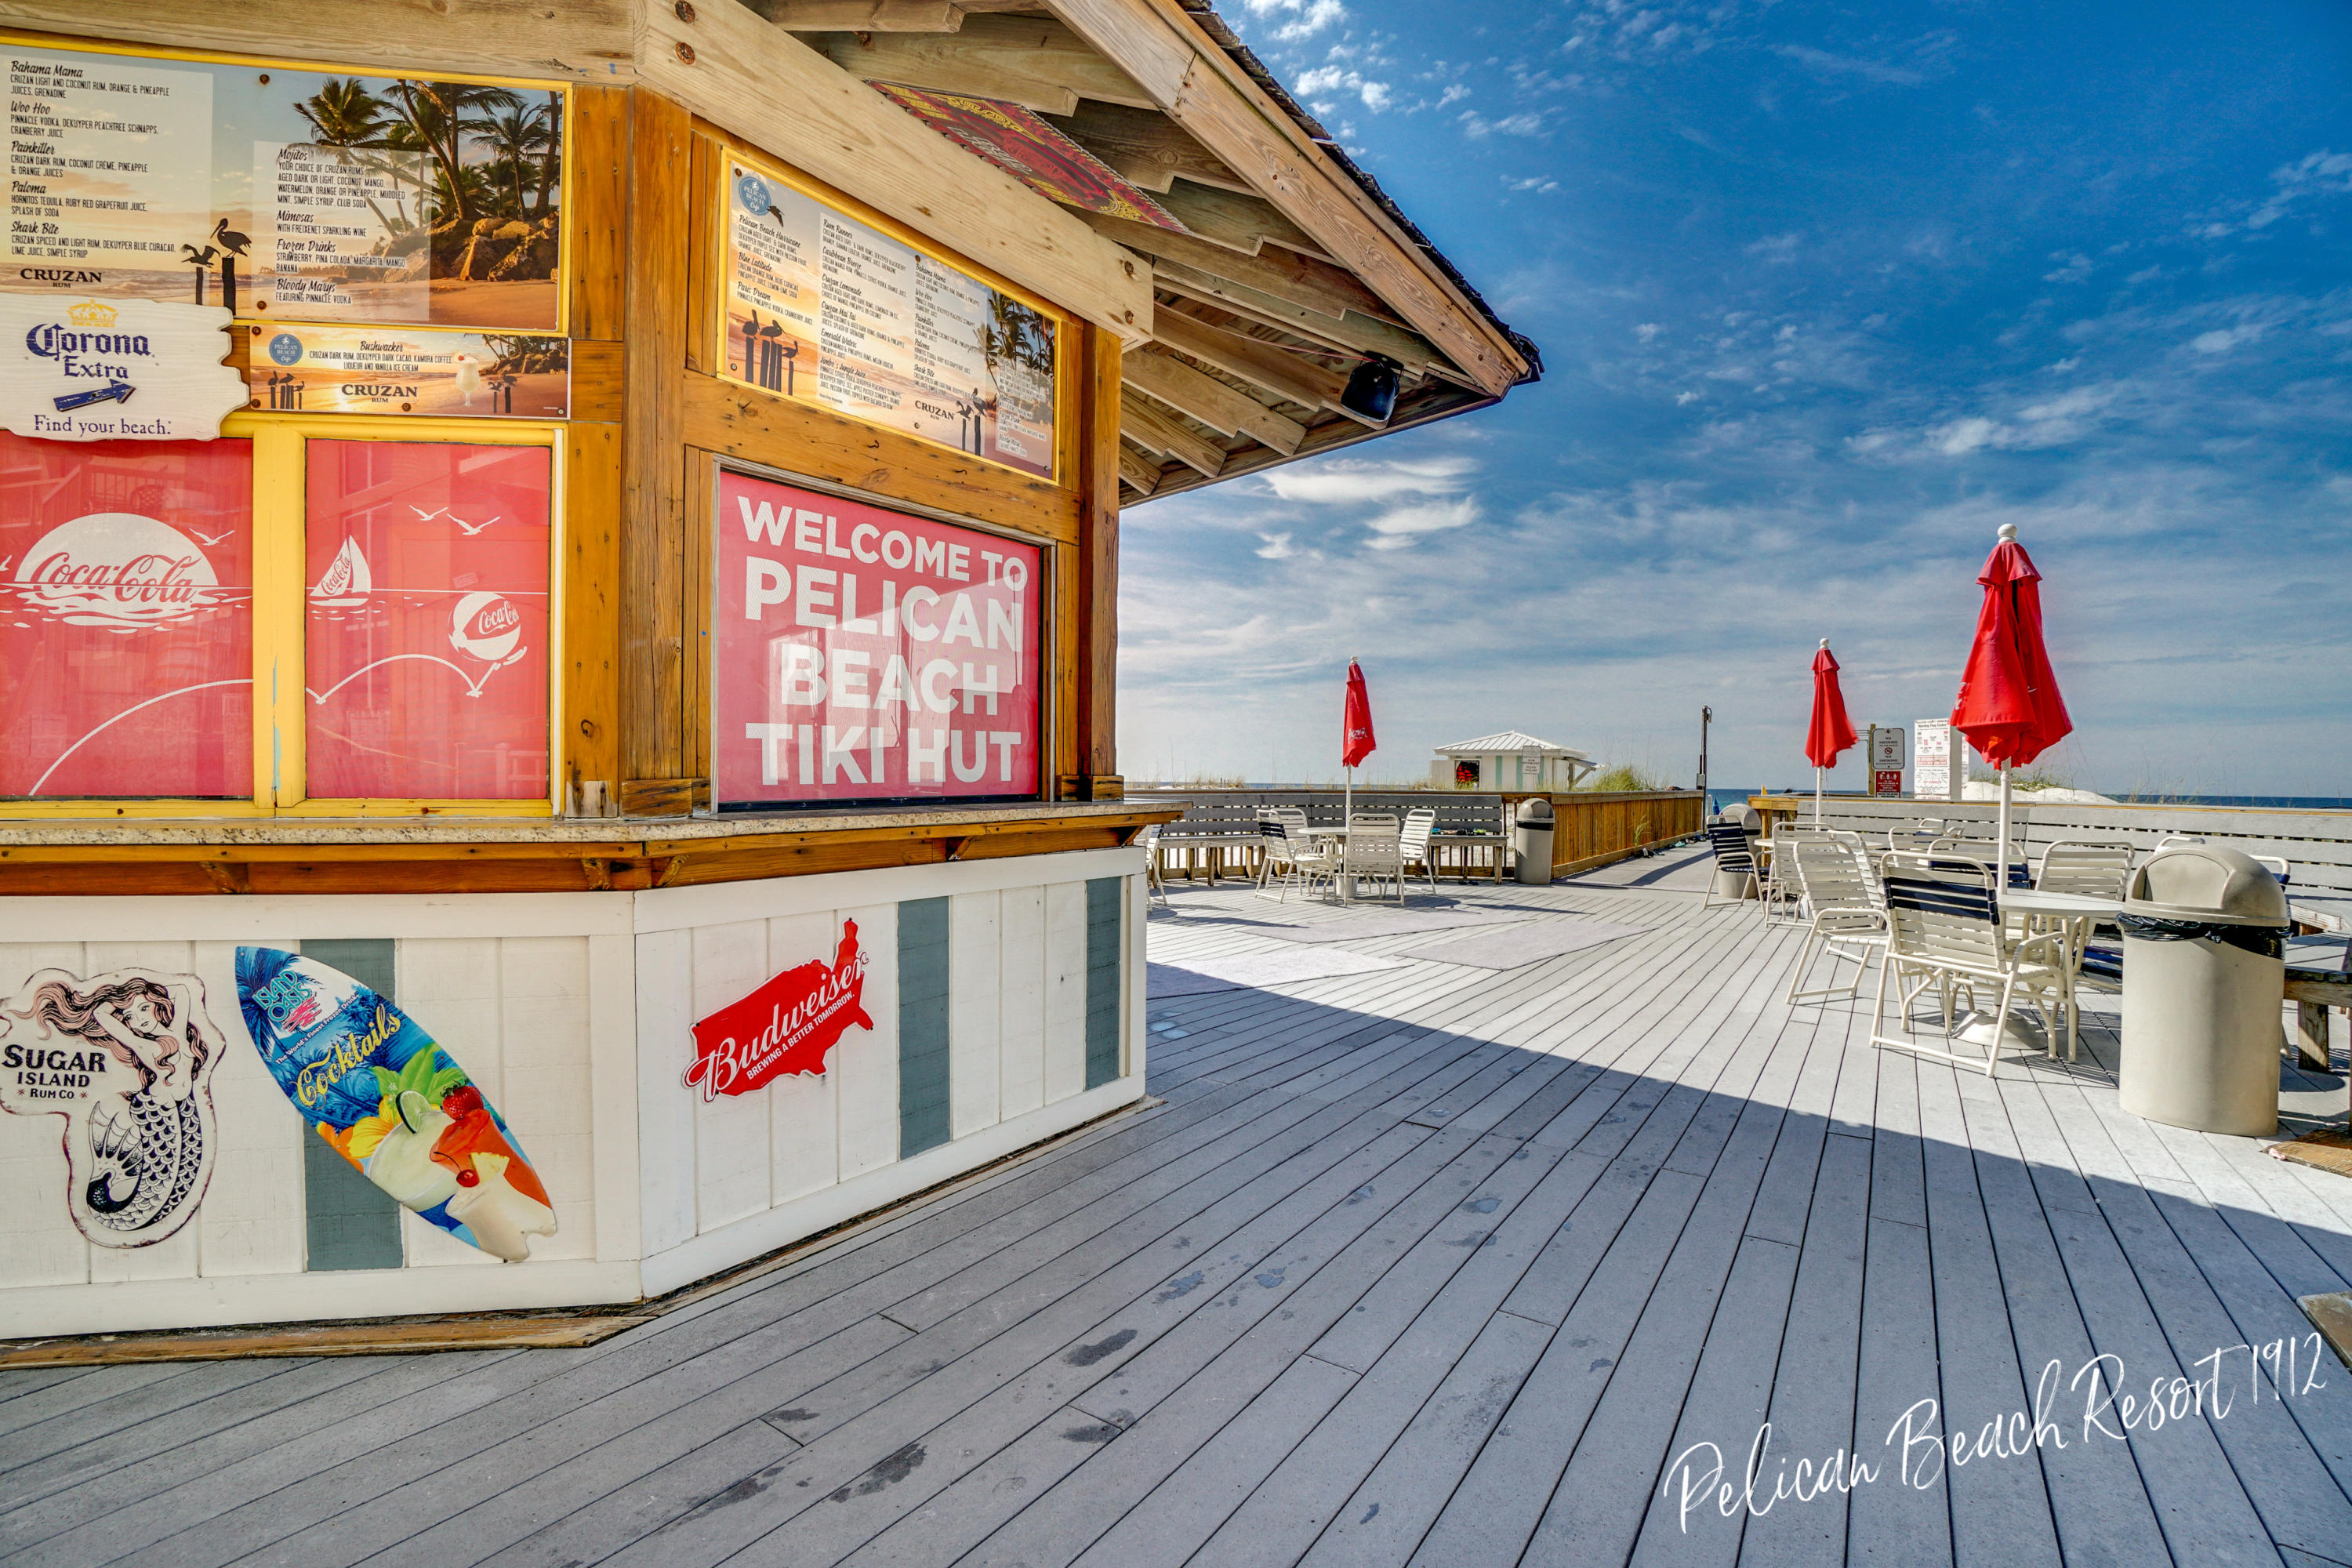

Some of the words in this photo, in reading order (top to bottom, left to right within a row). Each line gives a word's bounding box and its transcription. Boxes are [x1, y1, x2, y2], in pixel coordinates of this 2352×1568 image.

[11, 60, 50, 74] Bahama
[53, 65, 82, 77] Mama
[10, 74, 33, 84] CRUZAN
[35, 77, 50, 85] LIGHT
[53, 78, 64, 87] AND
[66, 79, 91, 89] COCONUT
[109, 83, 130, 93] ORANGE
[133, 85, 137, 93] &
[140, 85, 169, 96] PINEAPPLE
[34, 88, 66, 98] GRENADINE
[11, 100, 29, 112] Woo
[33, 103, 50, 114] Hoo
[11, 114, 38, 125] PINNACLE
[63, 118, 93, 129] DEKUYPER
[95, 121, 125, 132] PEACHTREE
[11, 125, 44, 136] CRANBERRY
[47, 129, 63, 137] JUICE
[11, 140, 55, 154] Painkiller
[278, 148, 307, 164] Mojitos
[11, 154, 34, 164] CRUZAN
[36, 156, 50, 165] DARK
[69, 158, 93, 168] COCONUT
[118, 162, 147, 172] PINEAPPLE
[11, 165, 16, 174] &
[18, 166, 40, 176] ORANGE
[43, 168, 63, 177] JUICES
[12, 180, 45, 194] Paloma
[11, 194, 38, 204] HORNITOS
[66, 198, 81, 207] RUBY
[83, 199, 93, 208] RED
[96, 200, 128, 209] GRAPEFRUIT
[11, 205, 33, 215] SPLASH
[35, 207, 42, 216] OF
[43, 208, 59, 216] SODA
[277, 210, 313, 222] Mimosas
[11, 221, 37, 233] Shark
[42, 223, 59, 234] Bite
[277, 223, 290, 232] WITH
[292, 224, 321, 234] FREIXENET
[323, 226, 350, 235] SPARKLING
[353, 228, 366, 237] WINE
[739, 214, 757, 229] Pelican
[760, 223, 774, 236] Beach
[776, 231, 800, 247] Hurricane
[823, 219, 834, 230] Rum
[837, 225, 852, 238] Runner
[12, 234, 34, 244] CRUZAN
[36, 236, 56, 245] SPICED
[58, 238, 69, 246] AND
[71, 238, 85, 247] LIGHT
[103, 240, 132, 249] DEKUYPER
[134, 241, 147, 250] BLUE
[277, 238, 304, 252] Frozen
[308, 240, 336, 252] Drinks
[12, 246, 24, 255] LIME
[47, 248, 67, 257] SIMPLE
[69, 249, 87, 258] SYRUP
[822, 246, 845, 262] Caribbean
[848, 257, 861, 269] Breeze
[739, 252, 750, 263] Blue
[752, 258, 771, 271] Latitude
[20, 268, 102, 282] CRUZAN
[277, 278, 306, 293] Bloody
[308, 280, 335, 294] Marys
[738, 281, 750, 293] Paris
[753, 287, 770, 300] Dream
[822, 274, 838, 286] Cruzan
[840, 281, 861, 296] Lemonade
[276, 292, 303, 302] FEATURING
[306, 293, 331, 303] PINNACLE
[333, 295, 350, 303] VODKA
[822, 300, 837, 314] Cruzan
[26, 323, 151, 361] Corona
[361, 340, 403, 351] Bushwacker
[821, 328, 840, 342] Emerald
[841, 336, 856, 348] Waters
[356, 352, 381, 361] DEKUYPER
[63, 355, 129, 379] Extra
[341, 384, 417, 397] CRUZAN
[915, 401, 953, 419] CRUZAN
[34, 415, 72, 432] Find
[78, 420, 115, 437] your
[738, 495, 970, 581] WELCOME
[981, 550, 1028, 592] TO
[31, 552, 202, 604] Coca-Cola
[746, 555, 1022, 652] PELICAN
[782, 643, 997, 716] BEACH
[746, 722, 885, 786] TIKI
[908, 728, 1022, 784] HUT
[252, 969, 299, 1010] ISLAND
[267, 983, 313, 1022] OASIS
[684, 950, 869, 1102] Budweiser
[274, 1055, 288, 1065] The
[285, 1038, 309, 1055] World's
[307, 1024, 325, 1039] Finest
[323, 1008, 343, 1025] Frozen
[747, 1047, 782, 1080] BREWING
[782, 1043, 789, 1053] A
[788, 1023, 814, 1047] BETTER
[814, 991, 855, 1026] TOMORROW.
[1, 1044, 107, 1073] SUGAR
[289, 1004, 401, 1109] Cocktails
[17, 1072, 90, 1088] ISLAND
